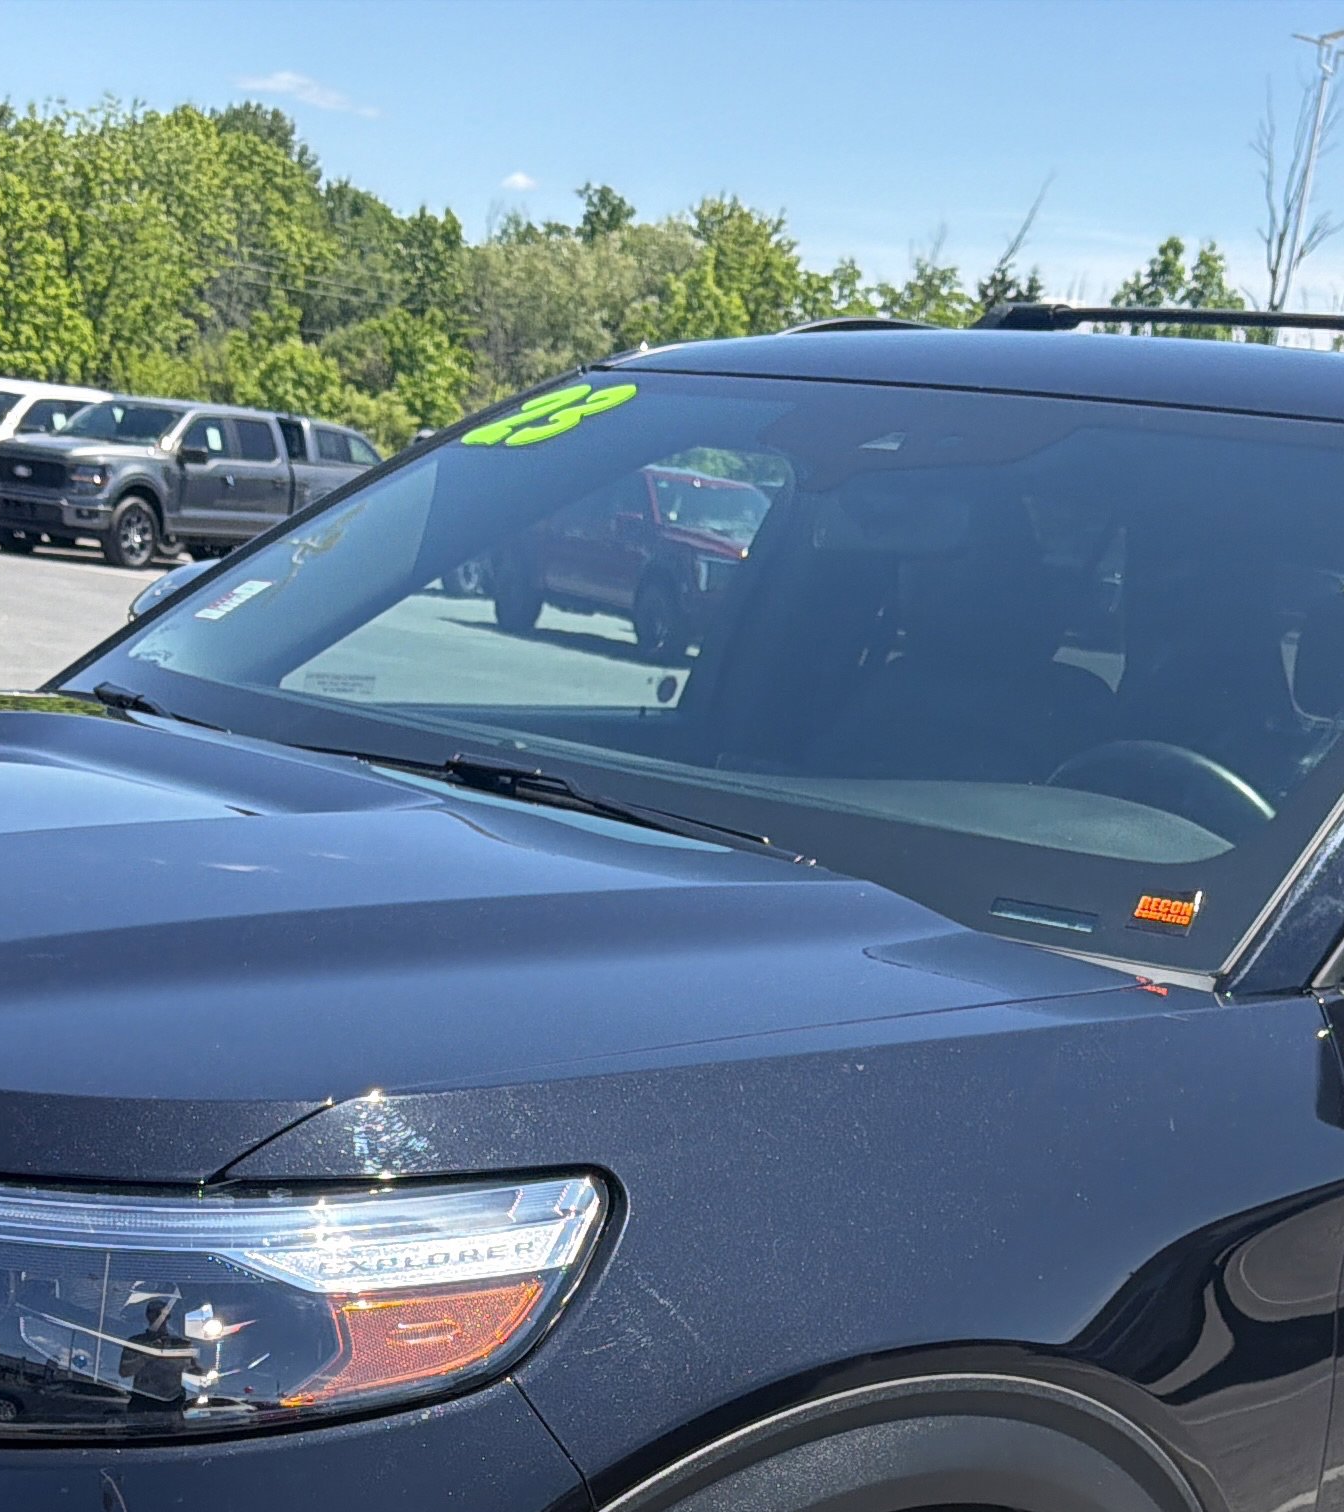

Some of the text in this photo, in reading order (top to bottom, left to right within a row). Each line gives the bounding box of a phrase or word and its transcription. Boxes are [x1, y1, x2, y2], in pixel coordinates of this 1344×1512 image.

[460, 384, 637, 446] 23
[1134, 908, 1190, 926] COMPLETED
[1138, 895, 1194, 917] RECON
[318, 1241, 534, 1275] EXPLORER
